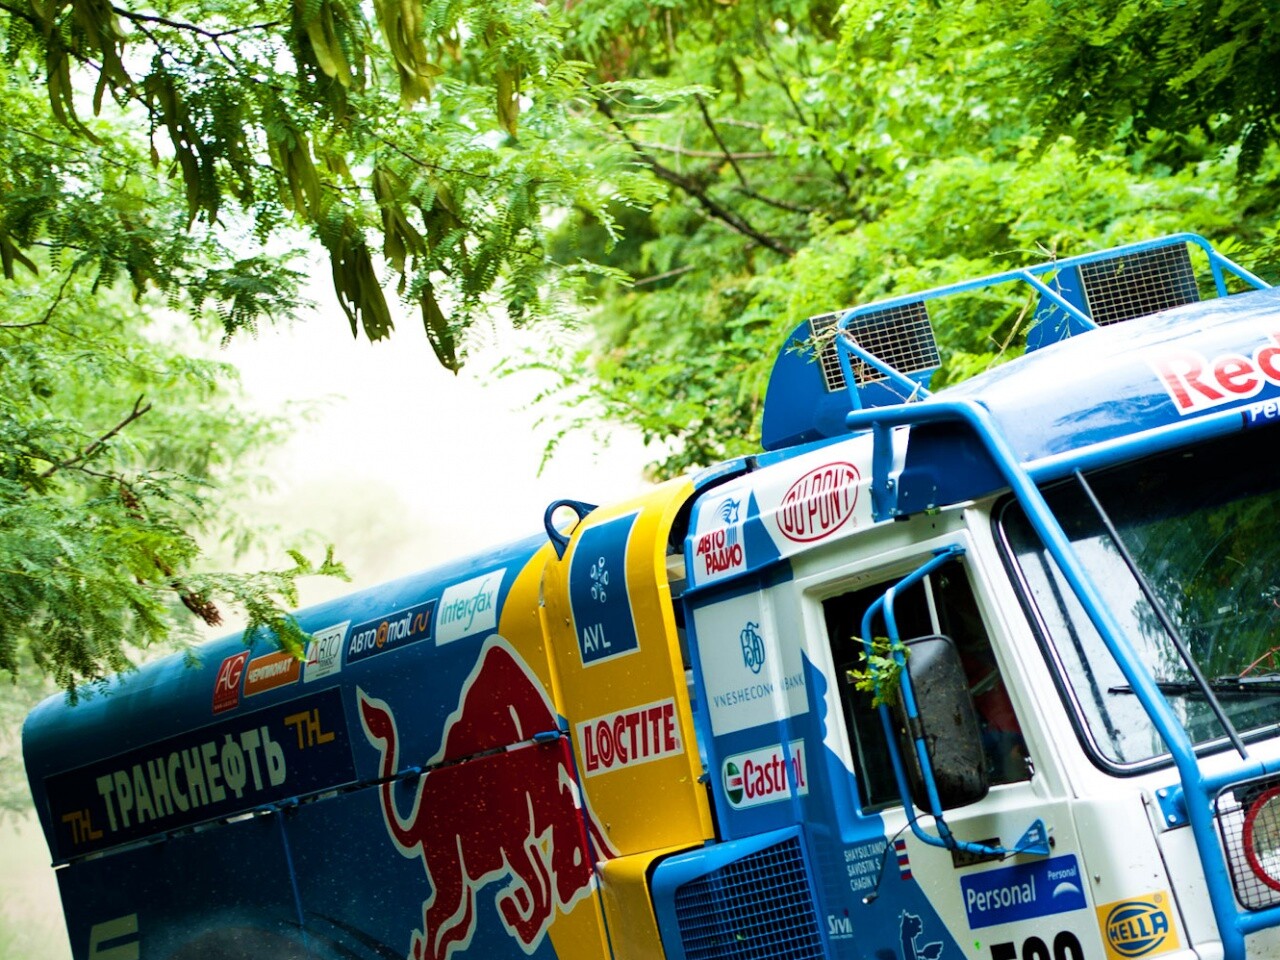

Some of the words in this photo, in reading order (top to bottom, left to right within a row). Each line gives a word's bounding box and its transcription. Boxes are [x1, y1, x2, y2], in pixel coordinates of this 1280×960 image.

[705, 544, 743, 575] РАДИО
[440, 578, 492, 632] interfax
[583, 623, 611, 654] AVL
[216, 655, 245, 695] AG
[584, 703, 677, 773] LOCTITE
[96, 725, 287, 832] ТРАНСНЕФТЬ
[966, 874, 1037, 914] Personal
[1047, 865, 1077, 881] Personal
[1109, 907, 1169, 943] HELLA
